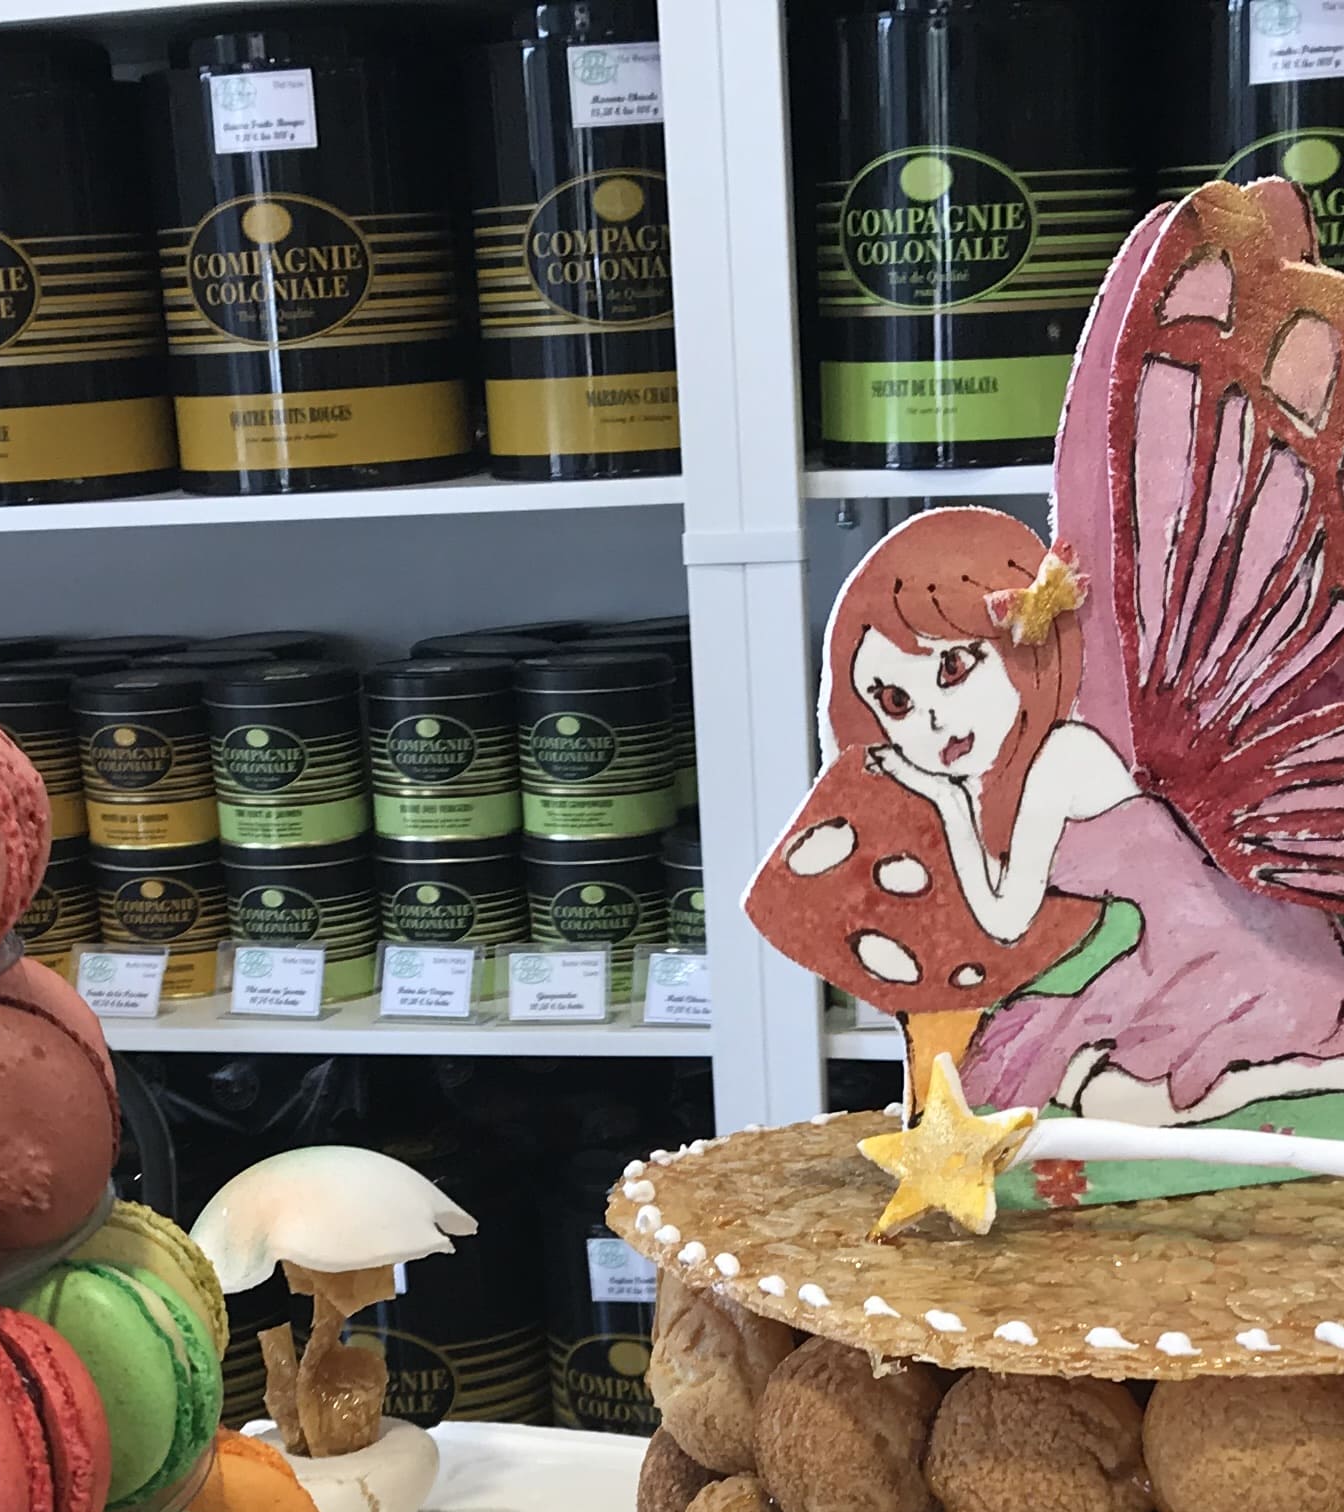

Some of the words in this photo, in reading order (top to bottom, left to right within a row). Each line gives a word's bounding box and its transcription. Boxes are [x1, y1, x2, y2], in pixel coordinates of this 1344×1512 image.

[846, 203, 1026, 238] COMPAGNIE
[532, 225, 670, 258] COMPAGN
[857, 236, 1010, 264] COLONIALE
[192, 246, 362, 280] COMPAGNIE
[547, 255, 669, 284] COLONIA
[205, 277, 350, 306] COLONIALE
